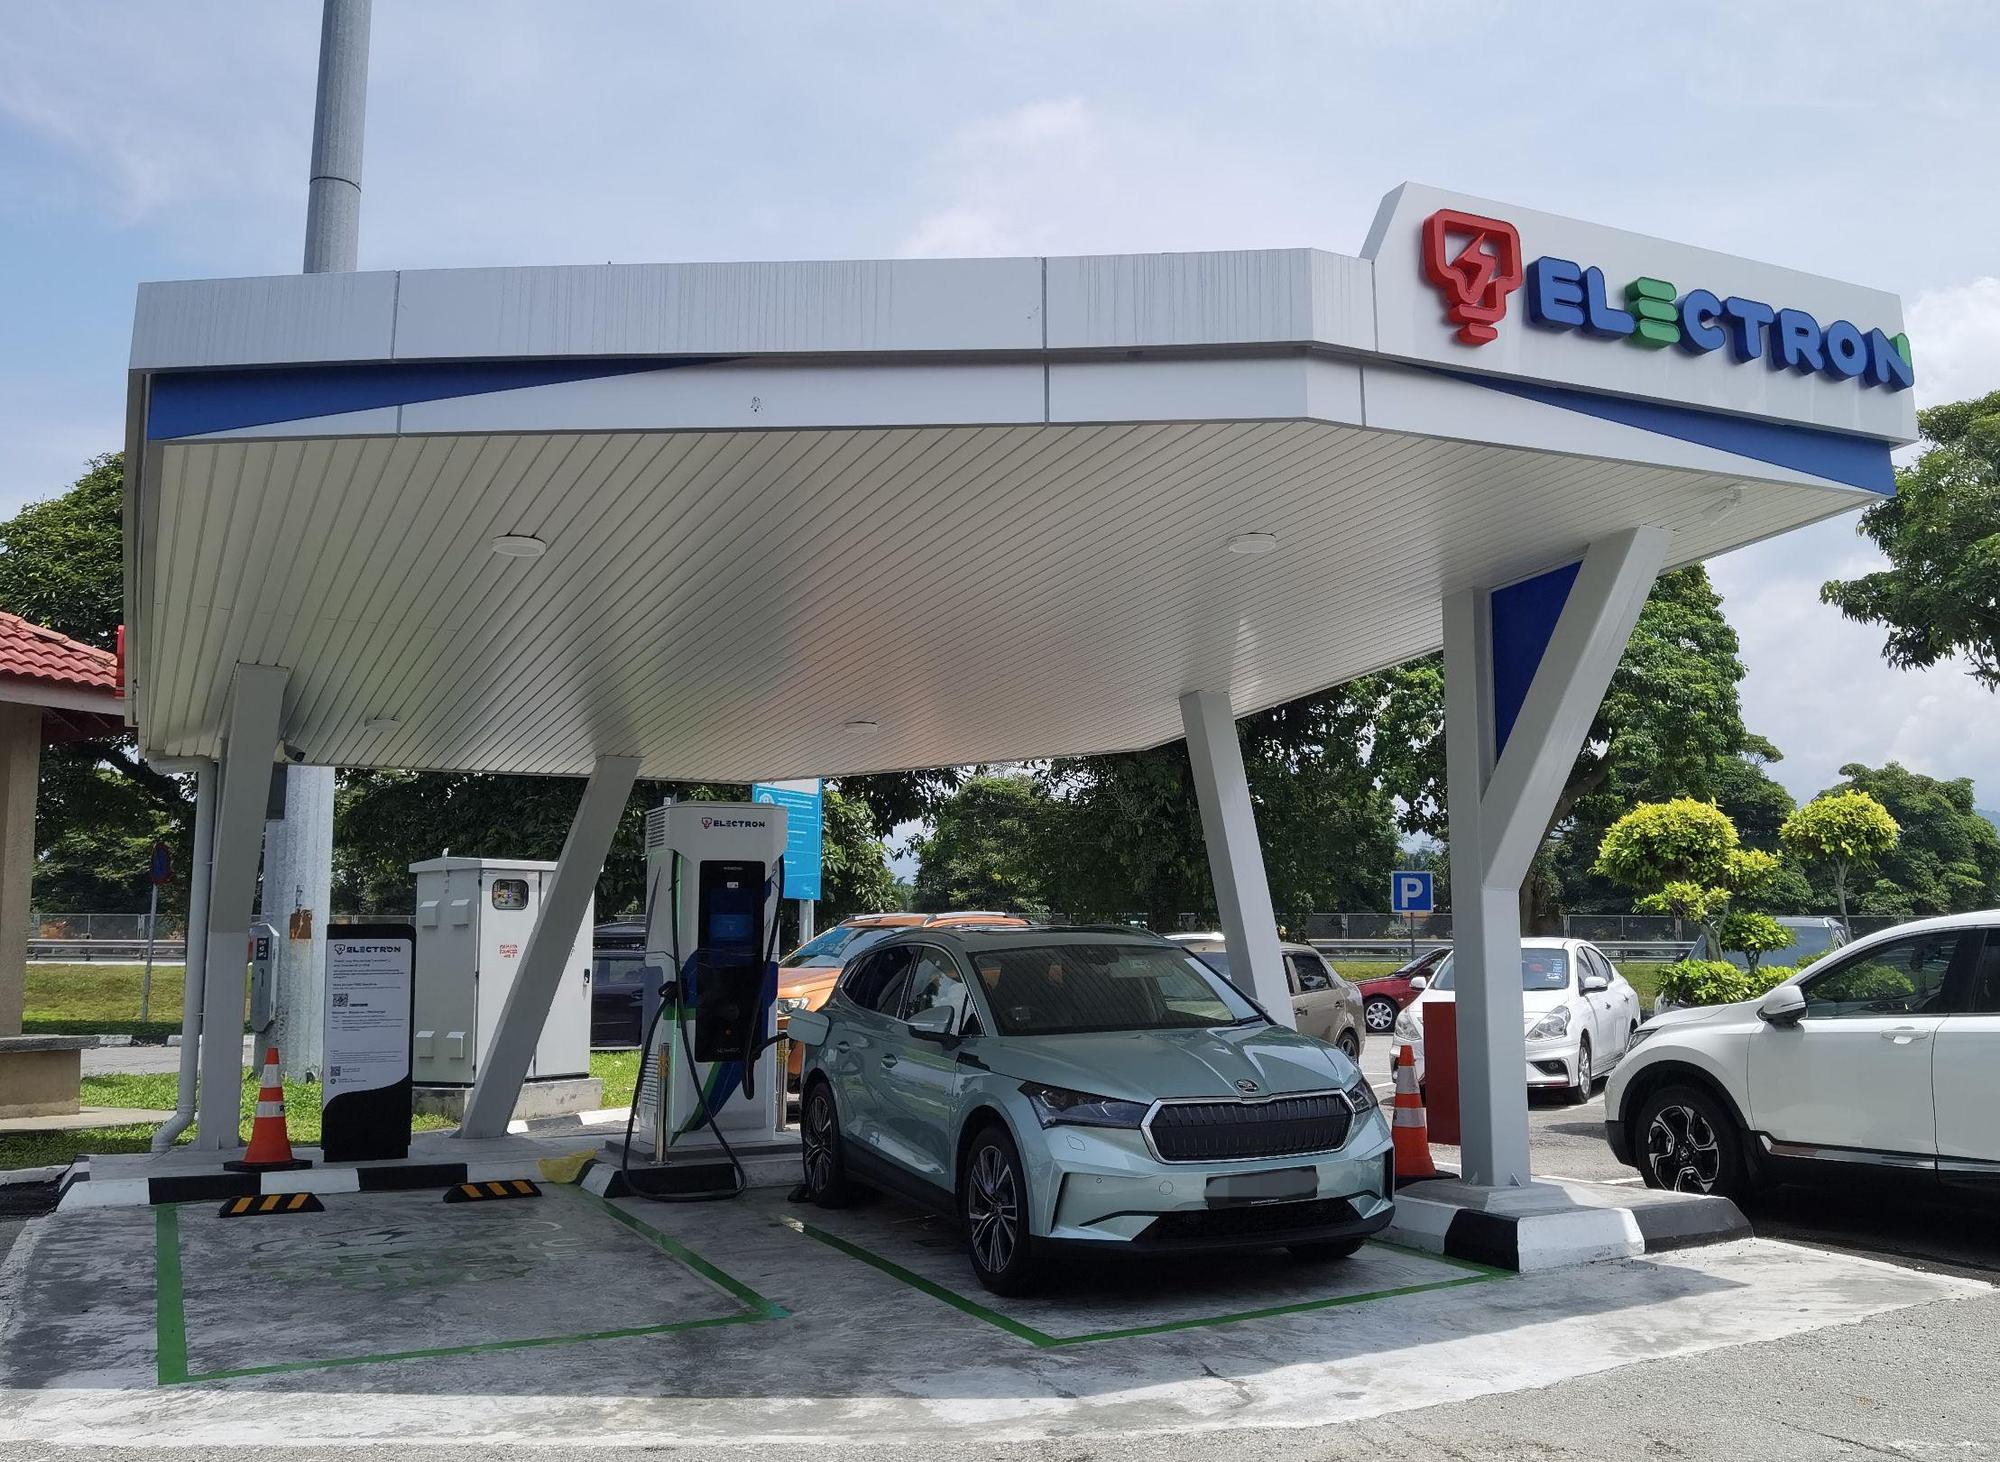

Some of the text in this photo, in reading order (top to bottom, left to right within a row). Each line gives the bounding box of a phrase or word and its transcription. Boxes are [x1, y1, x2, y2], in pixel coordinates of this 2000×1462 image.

[1527, 255, 1915, 391] ELECTRON
[713, 820, 766, 828] ELECTRON
[1401, 877, 1424, 909] P
